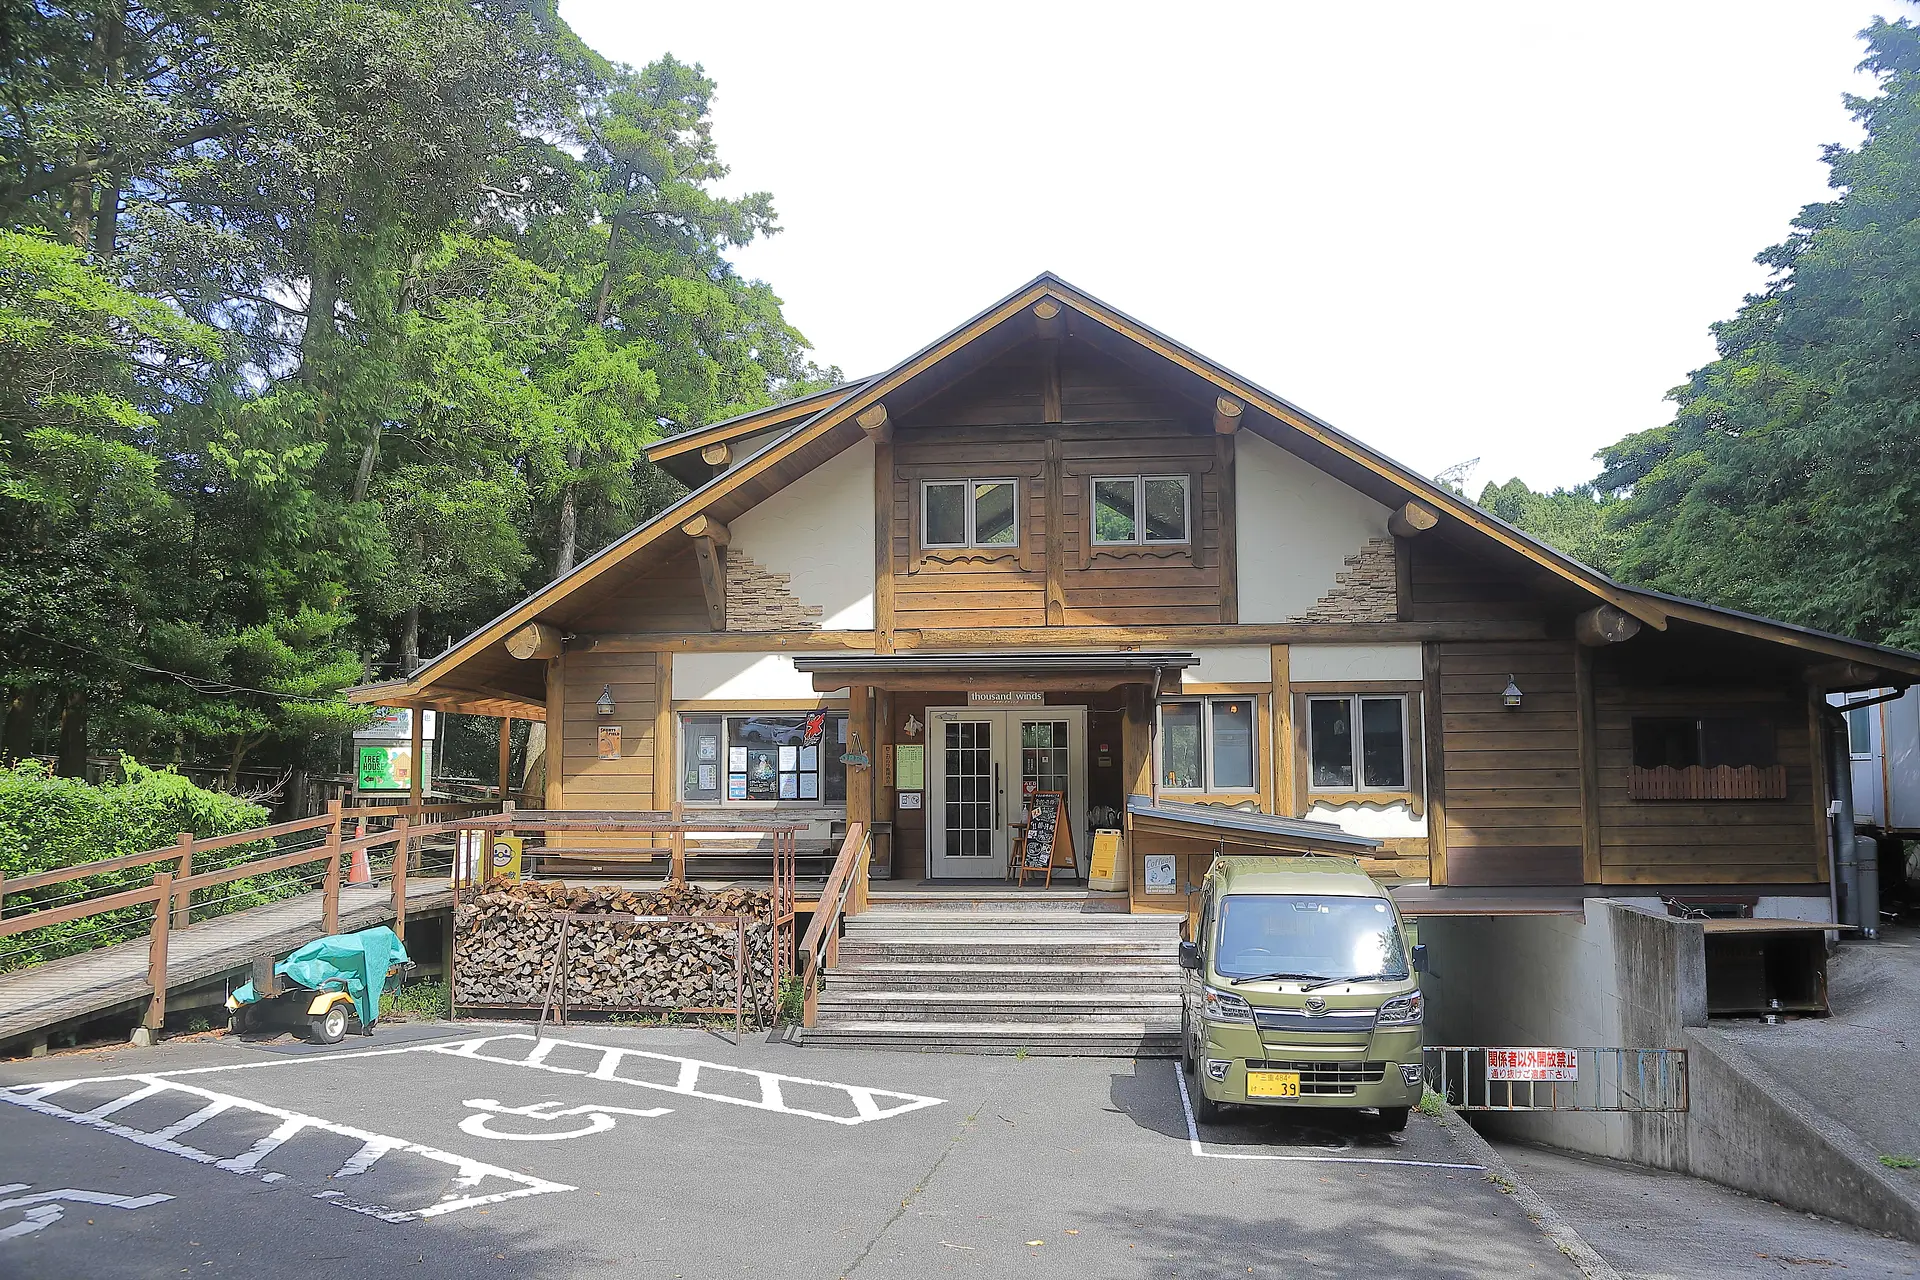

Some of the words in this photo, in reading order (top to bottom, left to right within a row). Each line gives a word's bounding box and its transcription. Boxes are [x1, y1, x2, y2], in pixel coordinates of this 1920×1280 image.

[971, 691, 1011, 700] thousand
[1016, 691, 1041, 700] winds
[363, 763, 384, 771] HOUSE
[1281, 1083, 1296, 1096] 39
